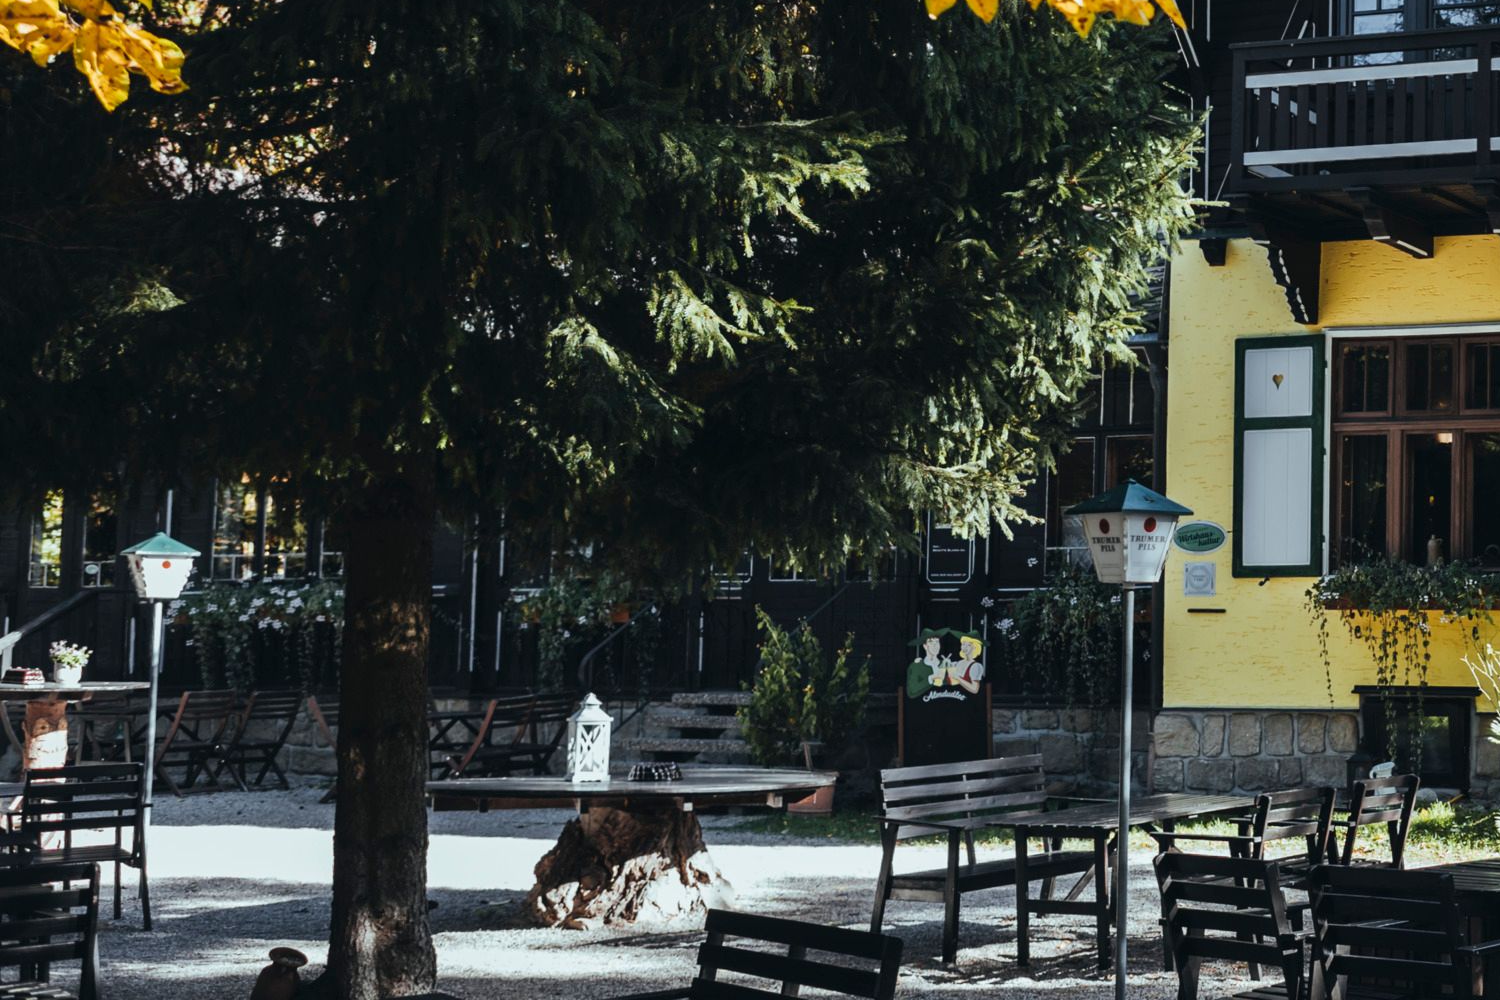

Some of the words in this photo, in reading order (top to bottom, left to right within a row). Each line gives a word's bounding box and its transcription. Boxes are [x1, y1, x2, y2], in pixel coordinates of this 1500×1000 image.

[1092, 536, 1121, 544] TRUMER
[1130, 535, 1167, 543] TRUMER
[1138, 543, 1157, 551] PILS
